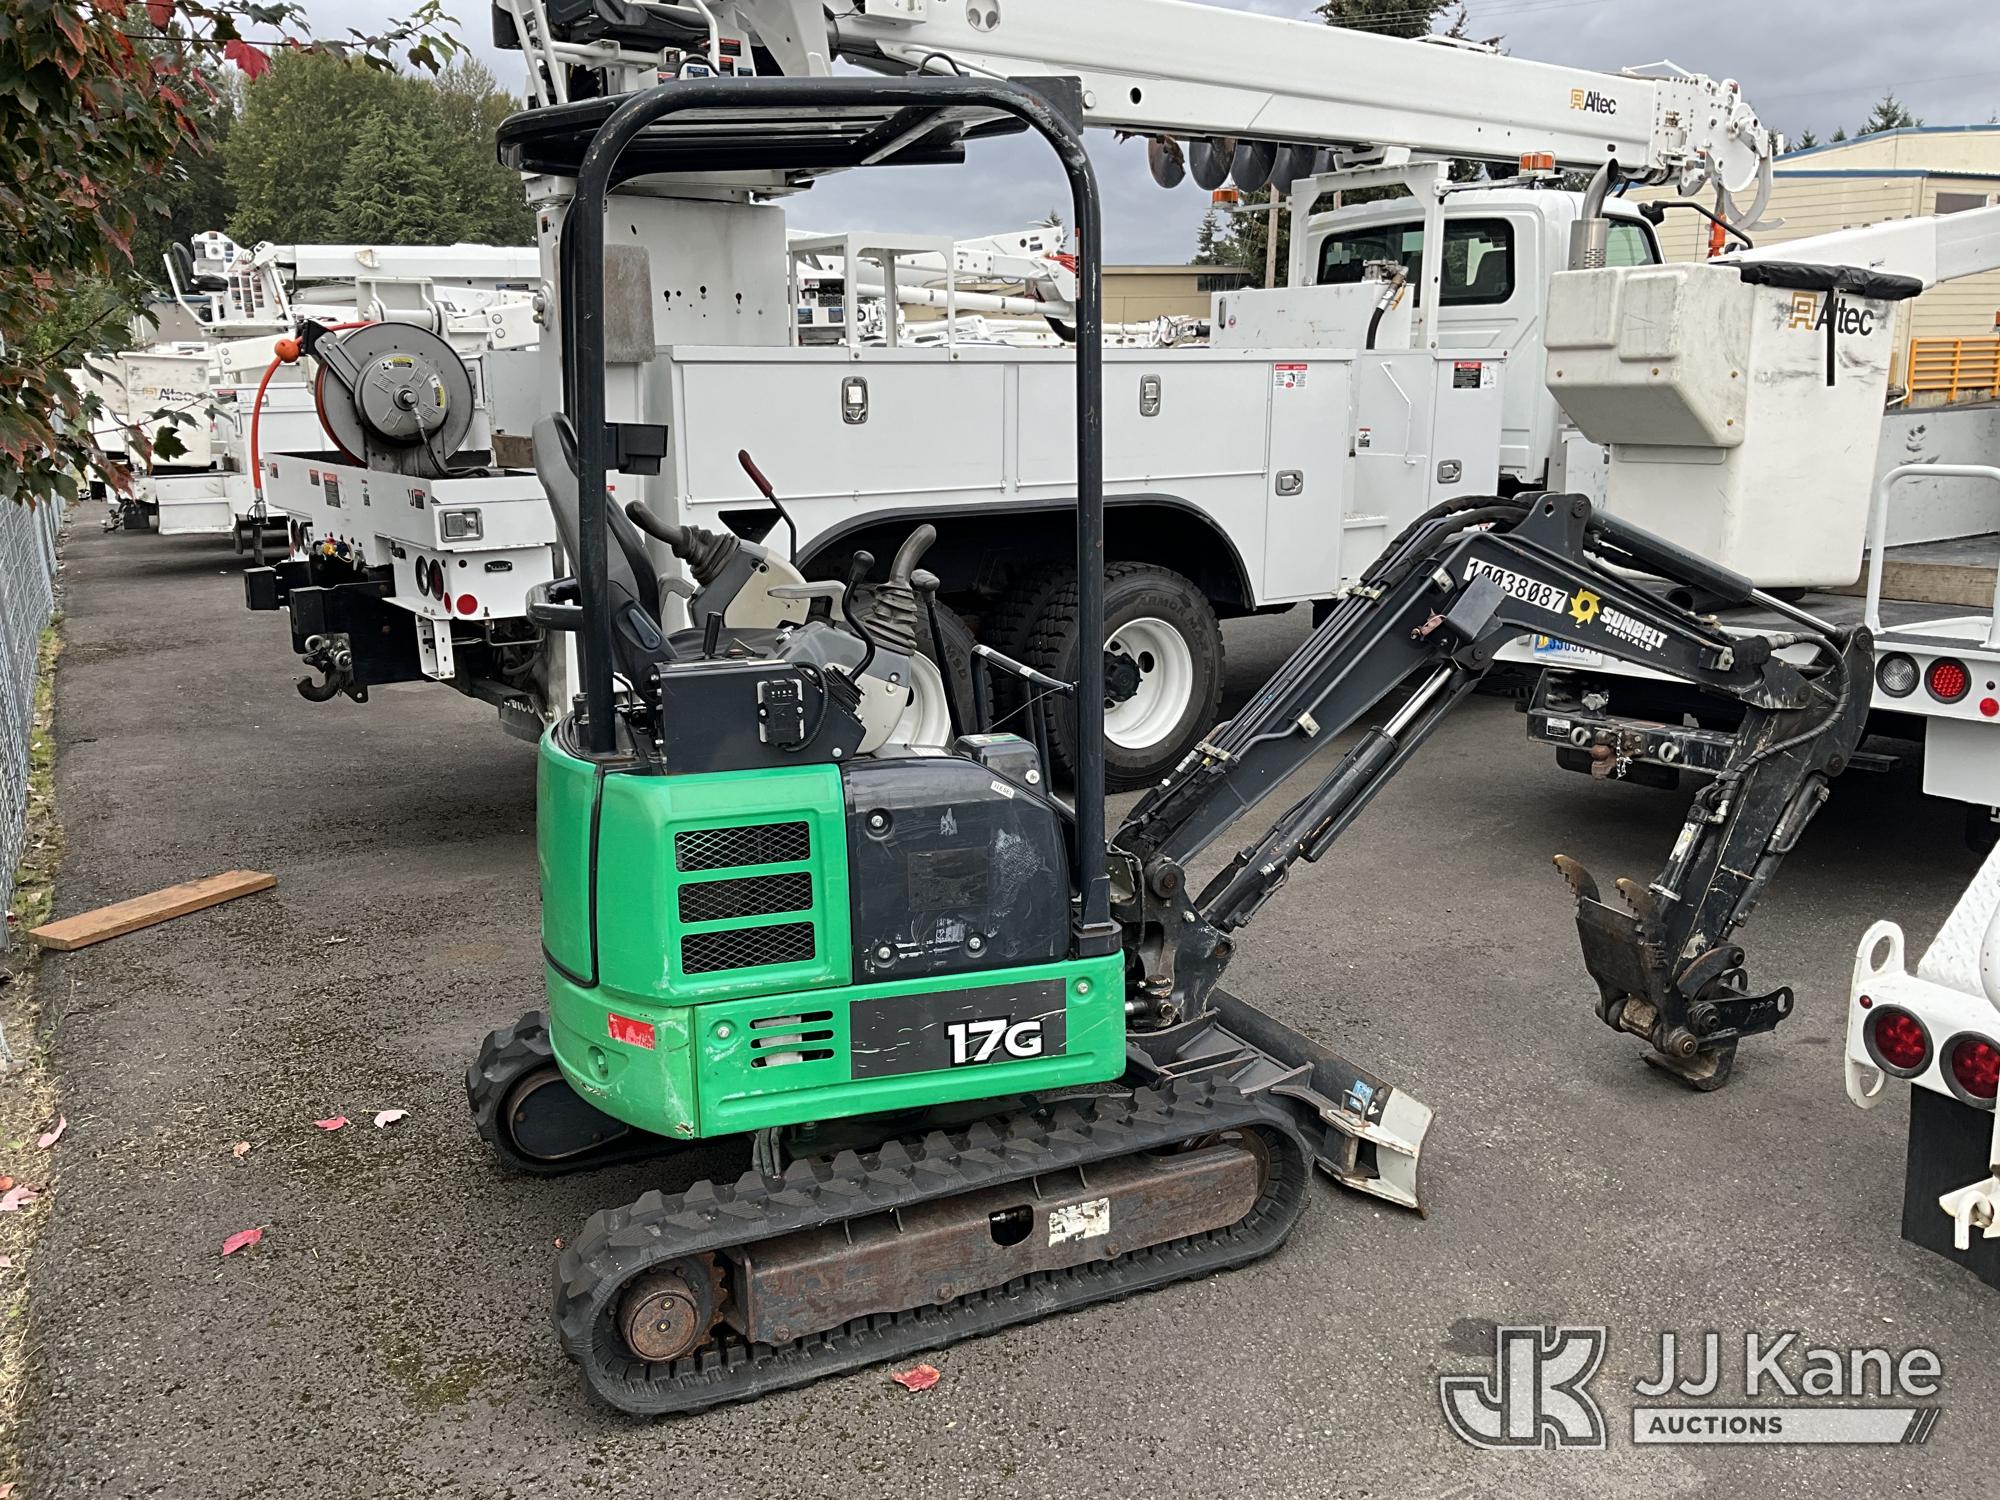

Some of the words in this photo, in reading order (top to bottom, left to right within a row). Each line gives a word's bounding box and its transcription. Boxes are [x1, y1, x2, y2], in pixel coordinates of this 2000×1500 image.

[1584, 91, 1616, 115] Altec
[1815, 296, 1874, 336] Altec
[1469, 561, 1566, 610] 10038087
[1600, 606, 1668, 649] SUNBELT
[1605, 626, 1653, 652] RENTALS
[946, 1017, 1043, 1065] 17G
